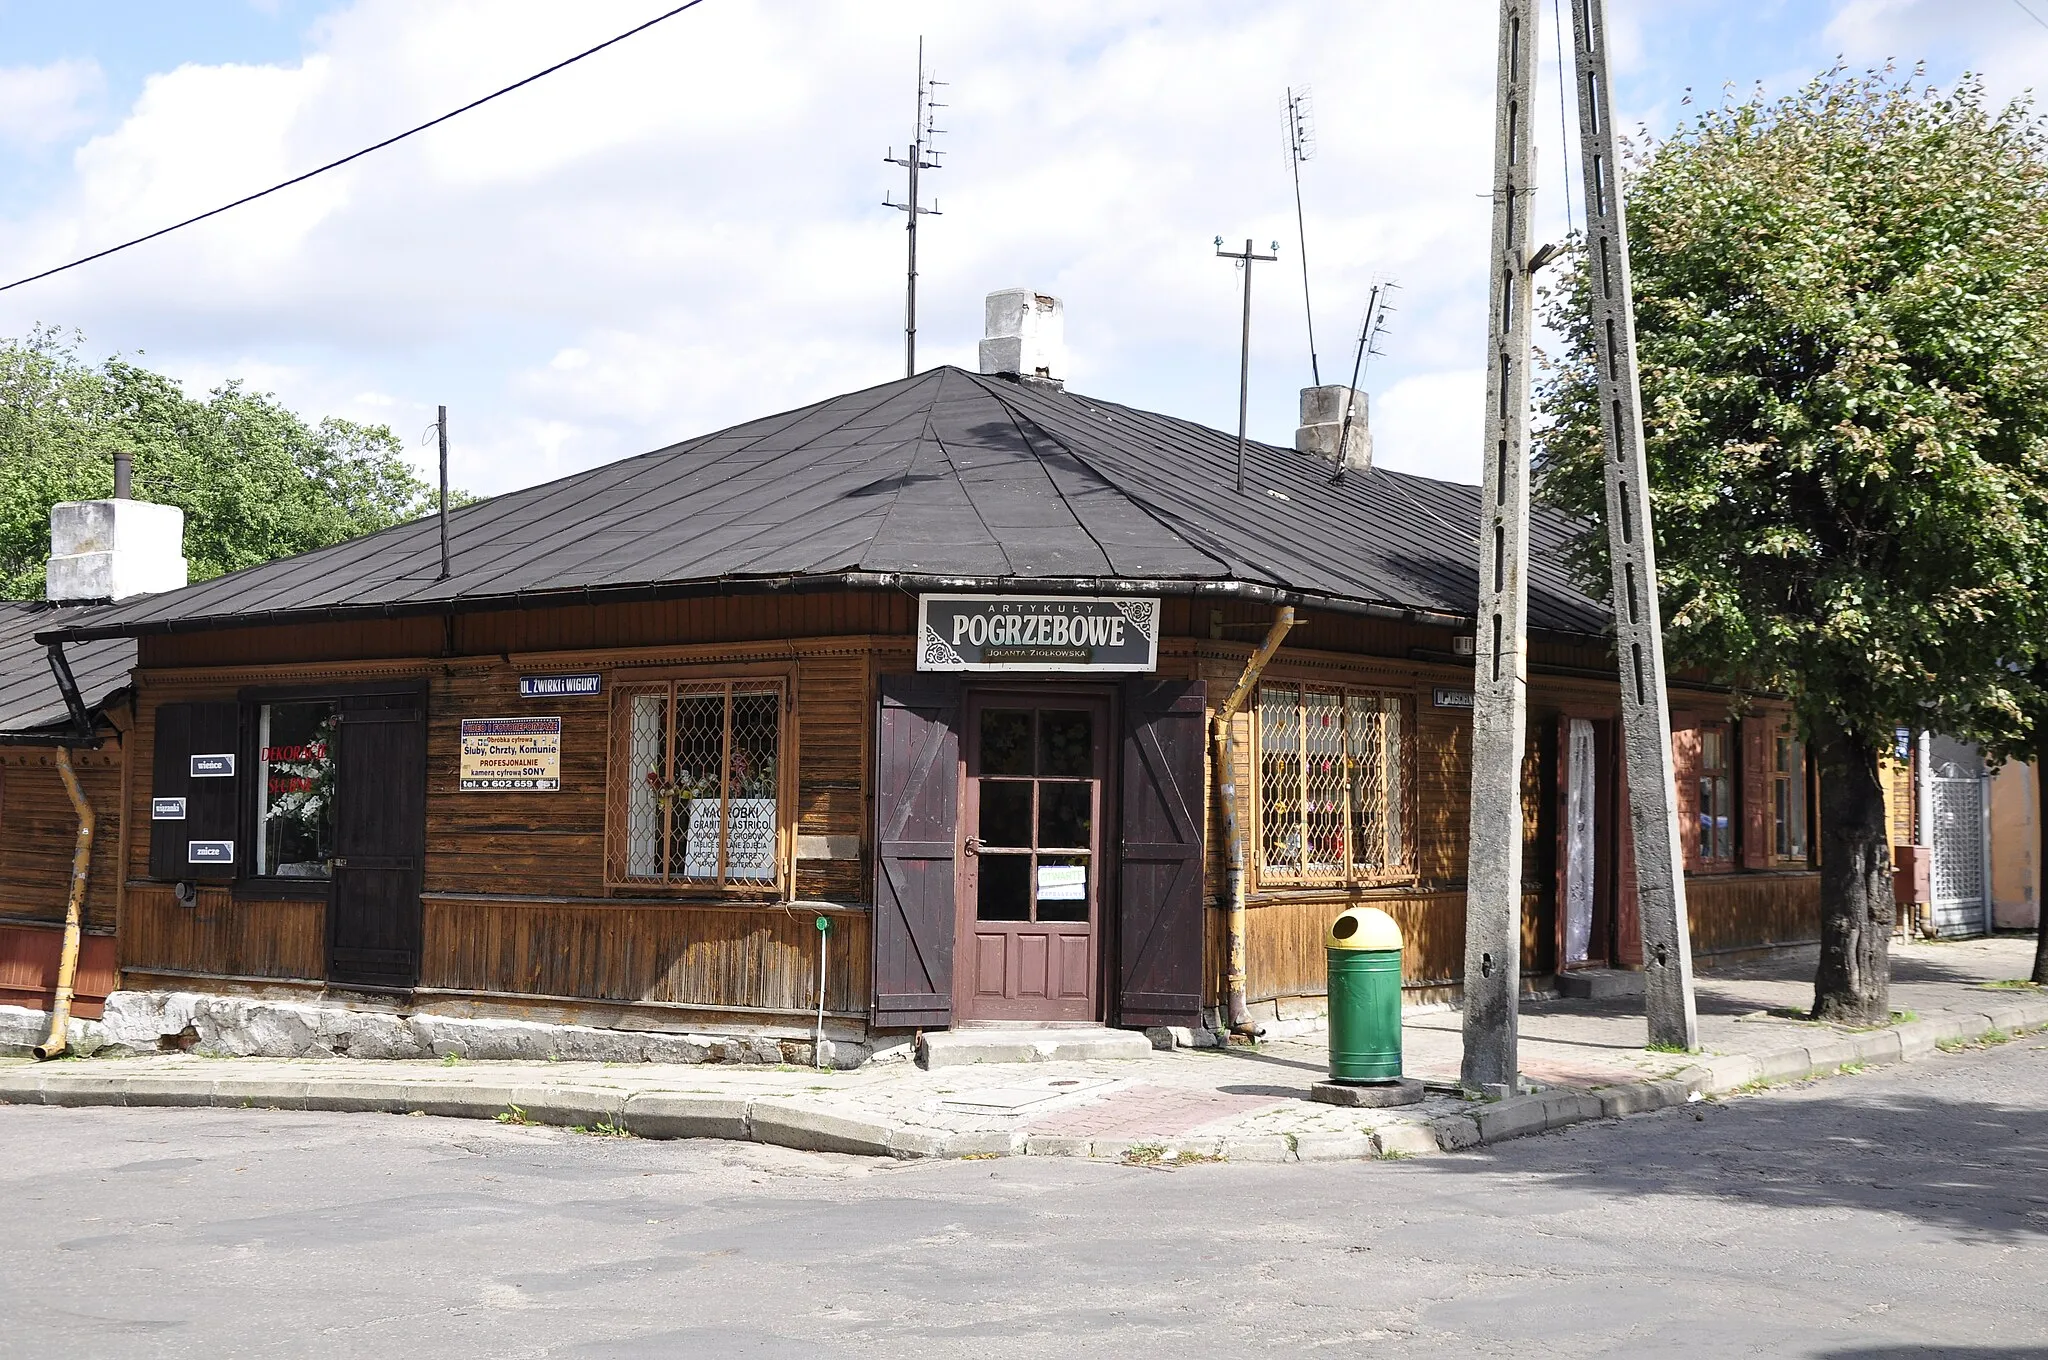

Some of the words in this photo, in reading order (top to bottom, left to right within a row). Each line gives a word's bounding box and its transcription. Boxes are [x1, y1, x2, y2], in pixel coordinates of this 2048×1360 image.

[988, 604, 1094, 614] ARTYKUŁY
[952, 614, 1126, 647] POGRZEBOWE
[987, 649, 1026, 657] JOLANTA
[533, 678, 561, 693] ŻWIRKI
[561, 680, 565, 692] i
[566, 677, 598, 692] WIGURY
[463, 723, 487, 733] VIDEO
[511, 736, 533, 744] cyfrowa
[261, 744, 327, 761] DEKORACJE
[464, 745, 487, 756] Śluby,
[489, 745, 517, 755] Chrzty,
[519, 744, 557, 754] Komunie
[197, 760, 223, 769] wieńce
[480, 759, 538, 767] PROFESJONALNIE
[471, 769, 494, 777] kamerą
[496, 769, 521, 777] cyfrową
[522, 768, 546, 776] SONY
[268, 776, 312, 793] ŚLUBNE
[463, 780, 479, 788] tel.
[481, 780, 489, 788] 0
[491, 780, 513, 788] 602
[514, 780, 533, 788] 659
[196, 846, 221, 855] znicze
